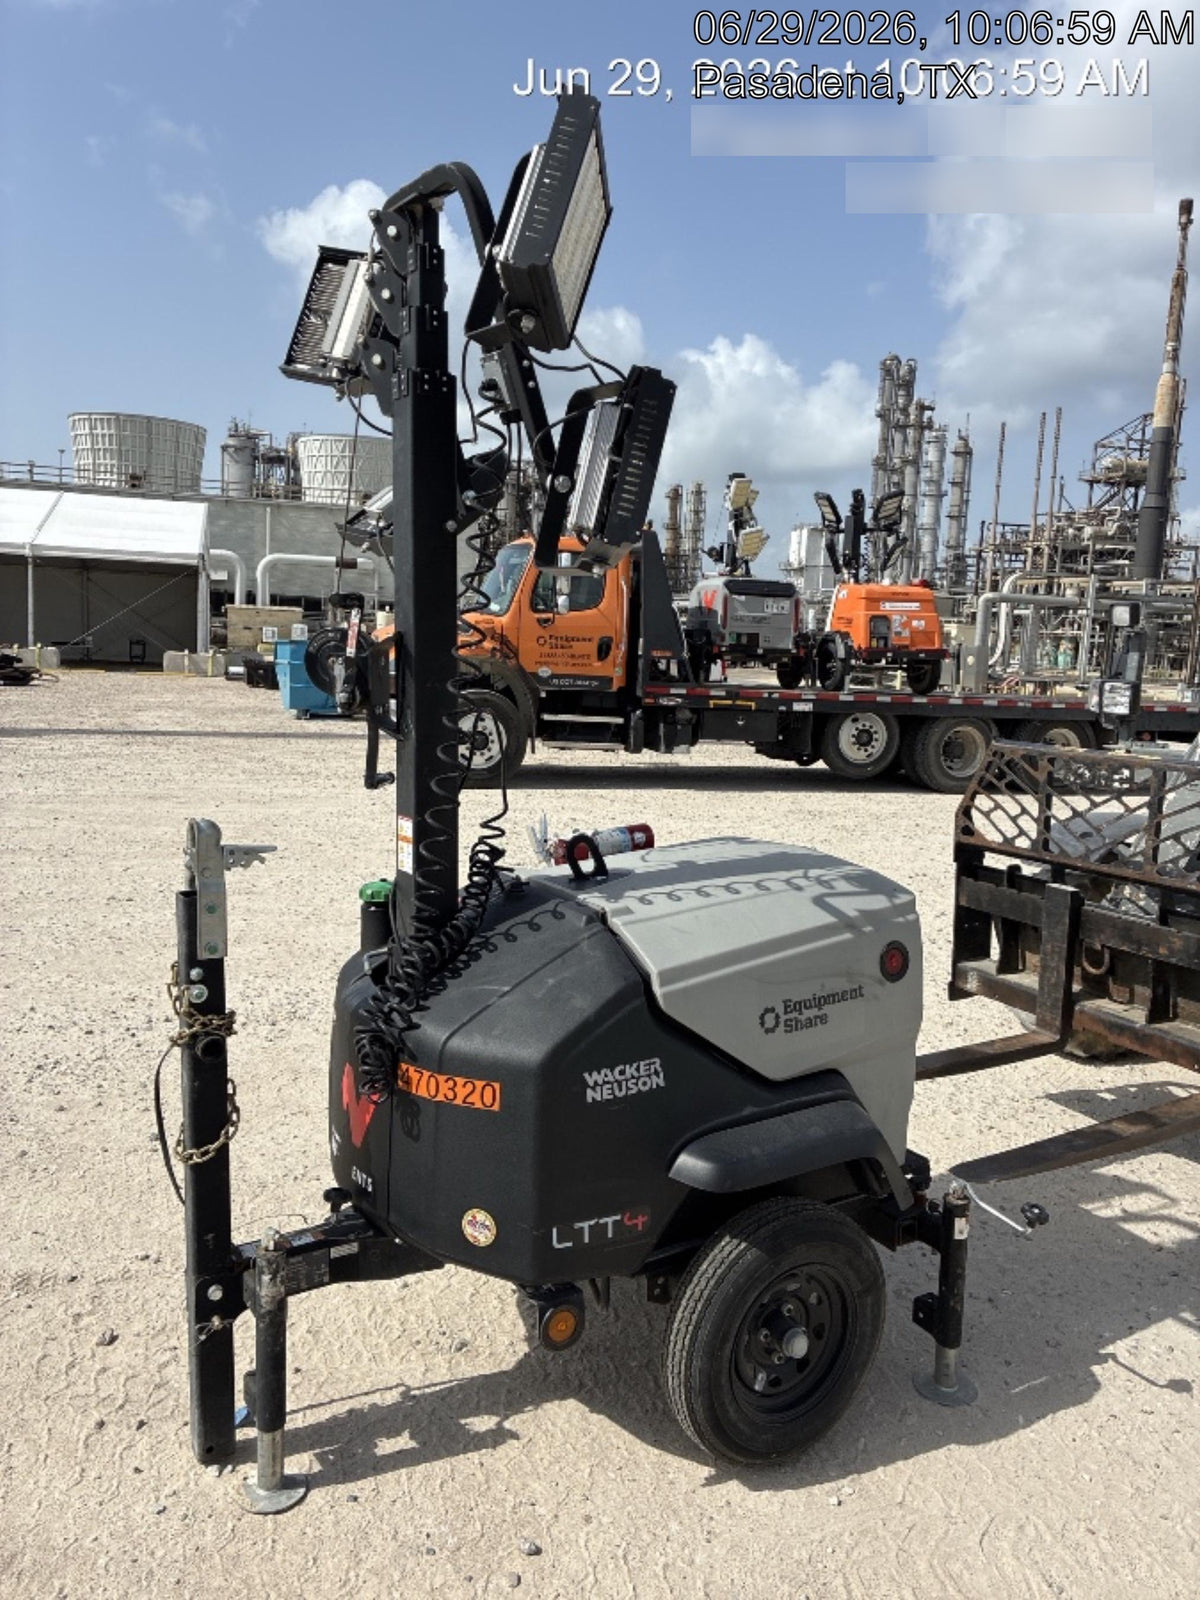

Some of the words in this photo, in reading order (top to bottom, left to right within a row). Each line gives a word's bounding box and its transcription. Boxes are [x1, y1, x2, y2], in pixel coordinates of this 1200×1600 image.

[782, 984, 865, 1015] Equipment
[783, 1012, 828, 1034] Share
[399, 1066, 497, 1109] 470320
[582, 1057, 662, 1087] WACKER
[586, 1071, 665, 1103] NEUSON
